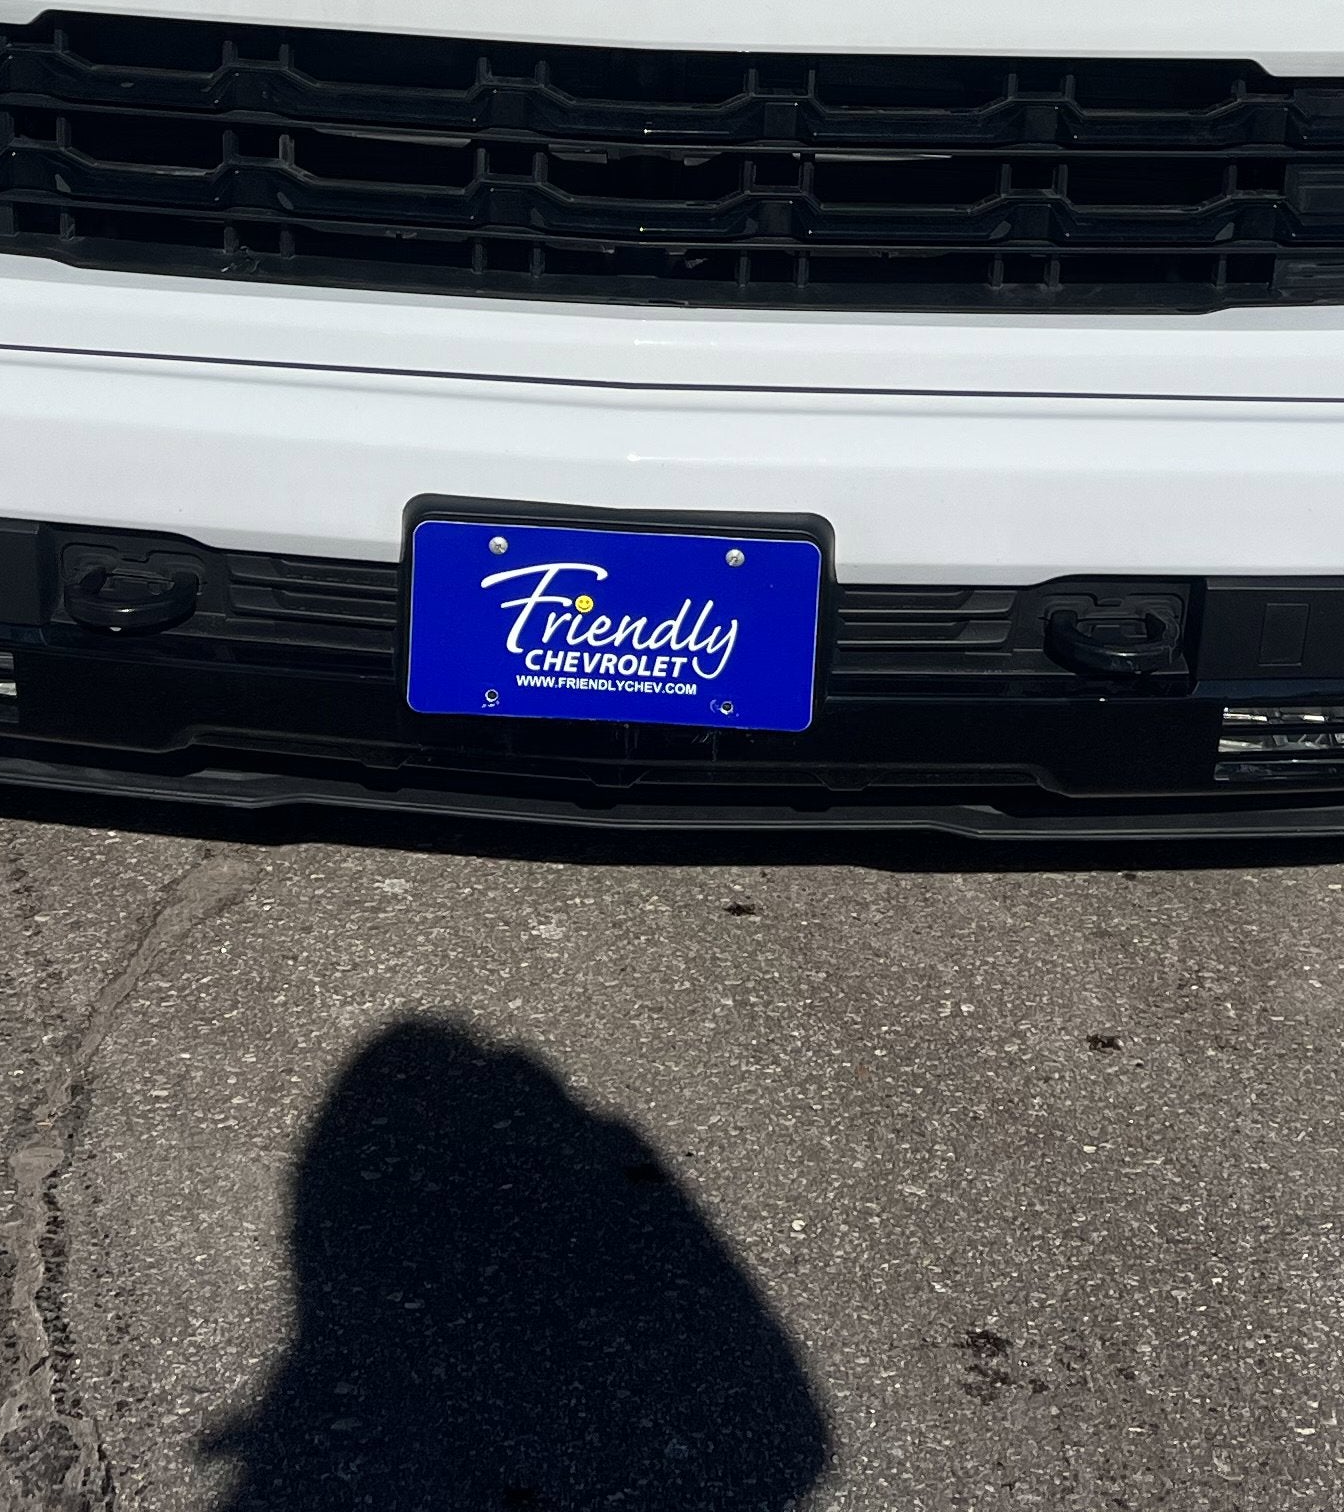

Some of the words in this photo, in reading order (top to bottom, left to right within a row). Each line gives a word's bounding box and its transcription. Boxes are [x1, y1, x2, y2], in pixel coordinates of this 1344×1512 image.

[480, 562, 739, 680] Friendly
[525, 649, 688, 678] CHEVROLET
[516, 675, 697, 695] WWW.FRIENDLYCHEV.COM
